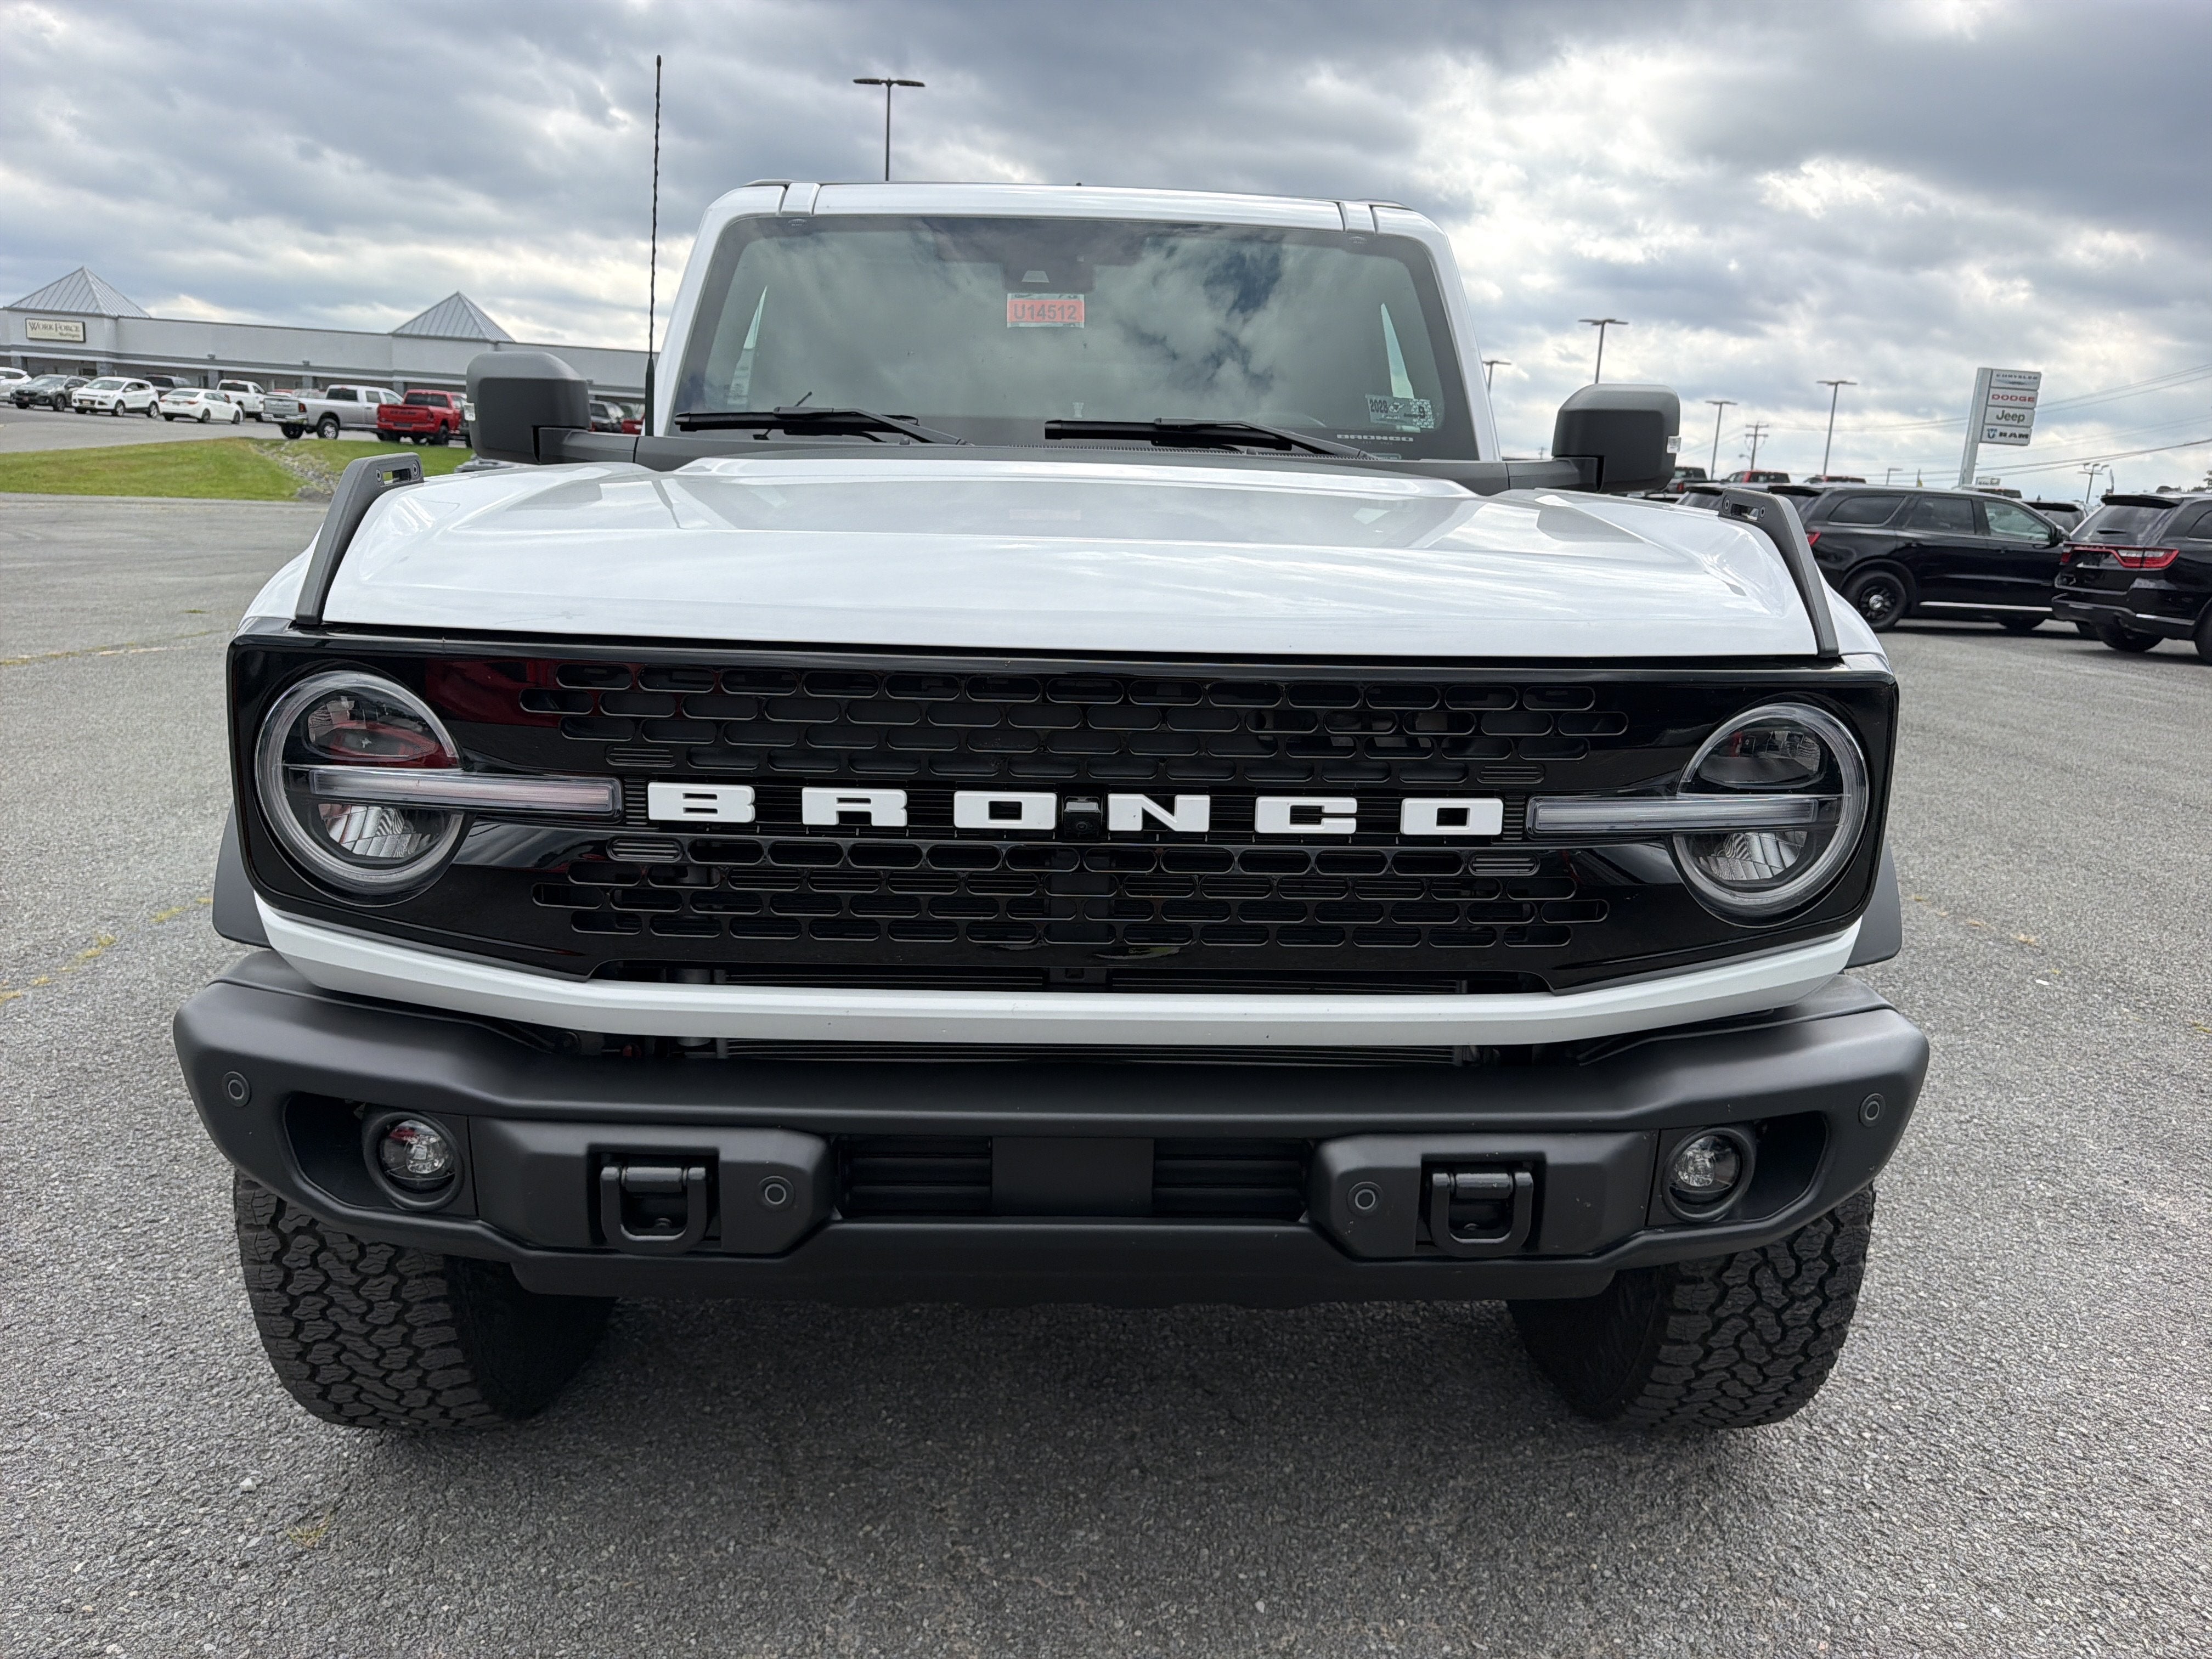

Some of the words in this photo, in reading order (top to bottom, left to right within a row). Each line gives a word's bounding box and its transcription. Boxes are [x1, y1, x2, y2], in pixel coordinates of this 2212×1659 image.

[1014, 304, 1077, 320] U14512
[1991, 394, 2035, 403] DODGE
[1369, 399, 1388, 414] 2028
[1996, 409, 2025, 424] Jeep
[648, 782, 1504, 836] BRONCO
